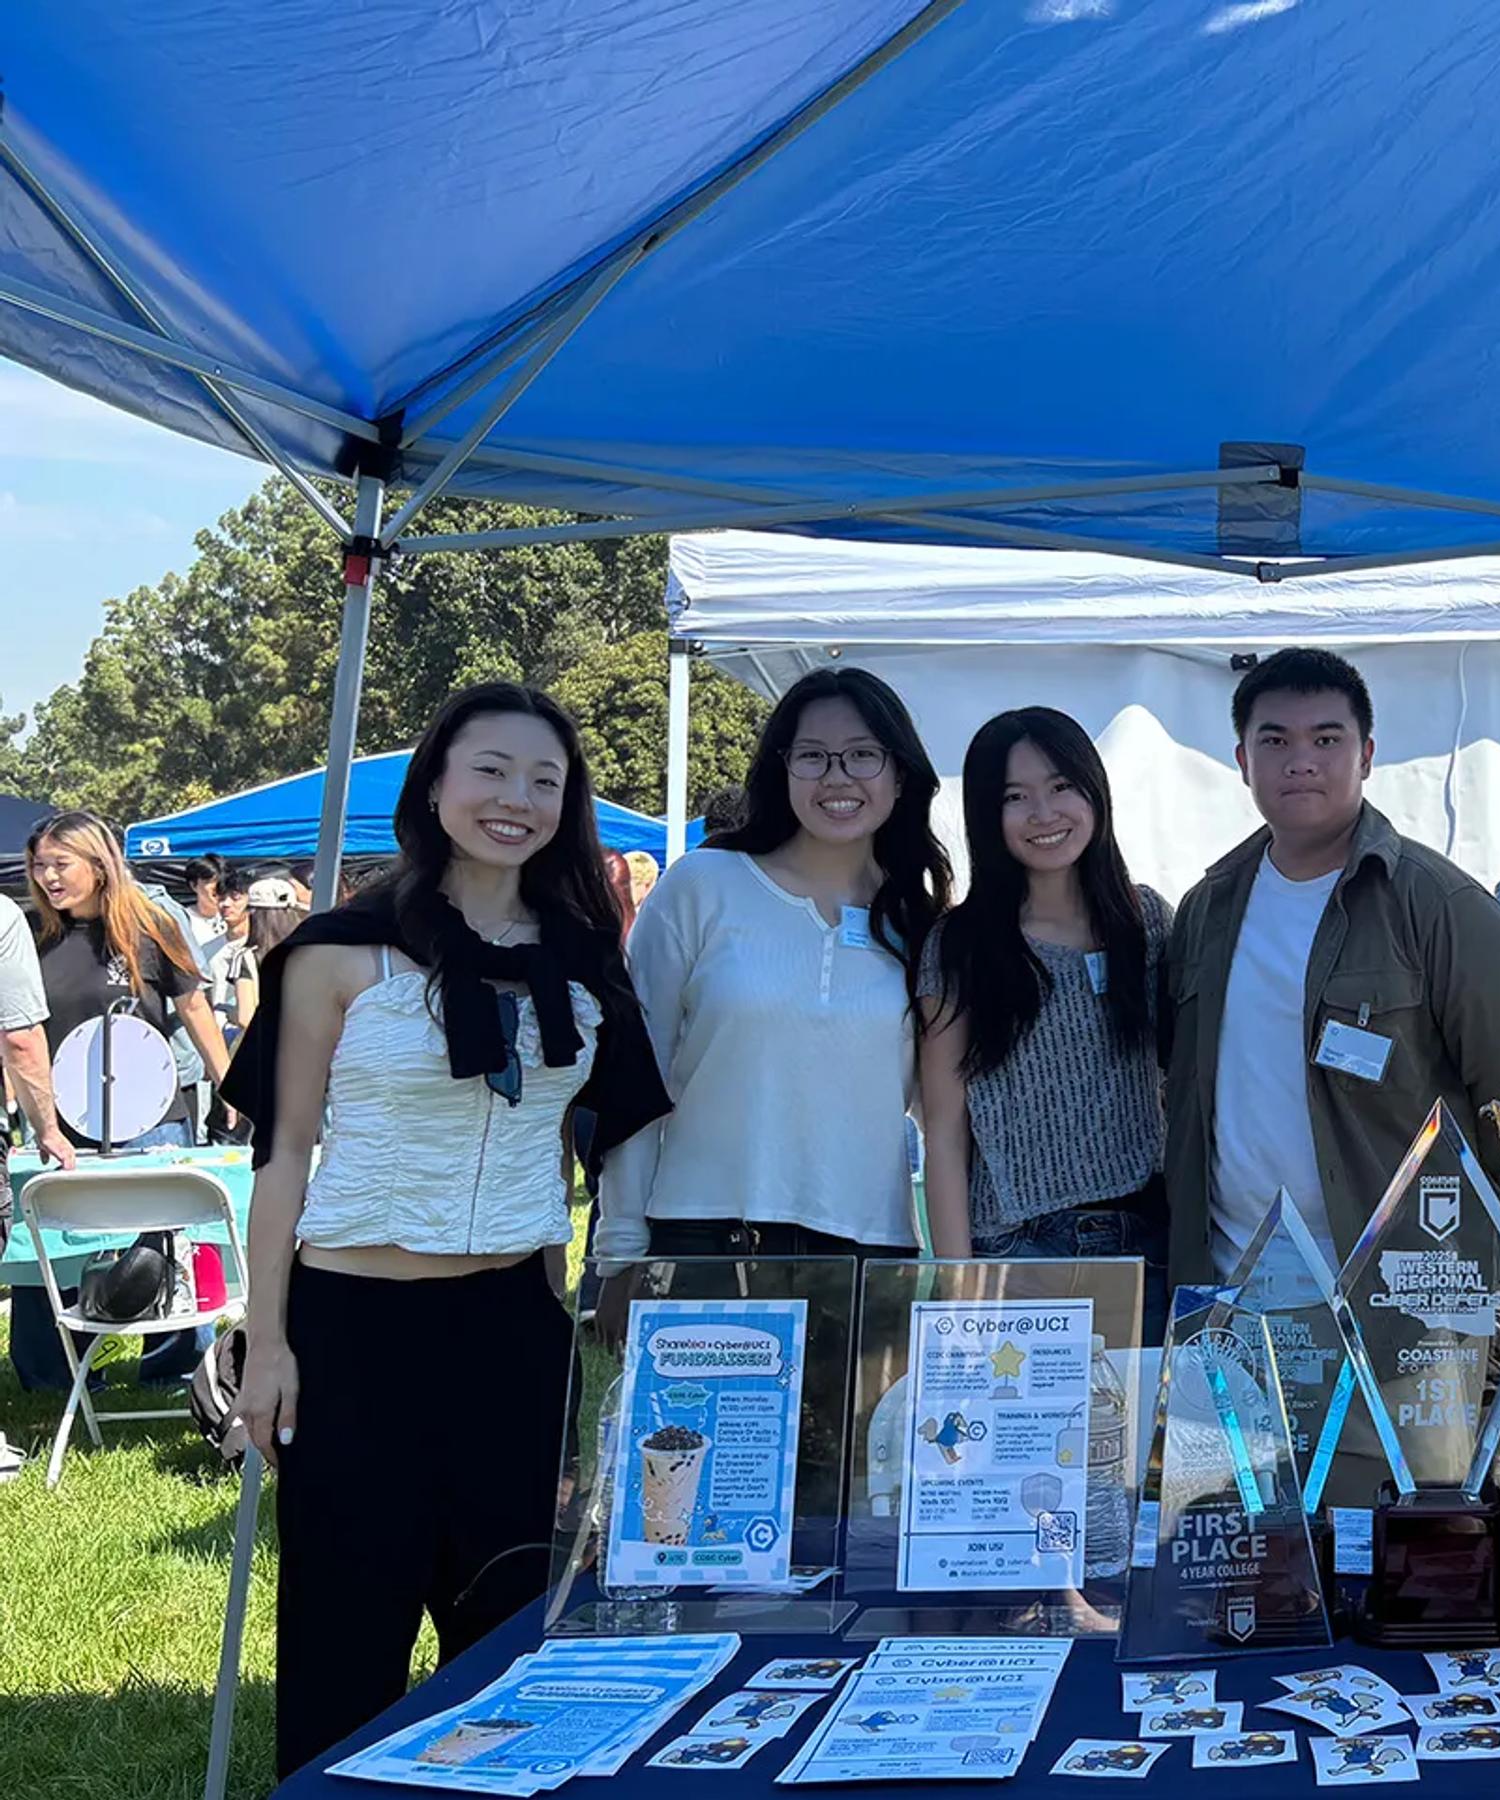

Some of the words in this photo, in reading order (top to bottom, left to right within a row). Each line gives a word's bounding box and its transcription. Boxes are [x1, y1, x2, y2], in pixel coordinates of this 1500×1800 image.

[1400, 1261, 1479, 1274] WESTERN
[1396, 1275, 1488, 1291] REGIONAL
[1369, 1293, 1429, 1306] CYBER
[962, 1316, 1070, 1336] Cyber@UCI
[660, 1351, 772, 1367] FUNDRAISER!
[1397, 1348, 1479, 1361] COASTLINE
[1416, 1378, 1458, 1401] 1ST
[1398, 1404, 1478, 1426] PLACE
[1178, 1511, 1256, 1537] FIRST
[1172, 1535, 1268, 1564] PLACE
[1180, 1567, 1188, 1580] 4
[1189, 1566, 1216, 1579] YEAR
[1216, 1562, 1260, 1577] COLLEGE
[921, 1658, 1038, 1668] Cyber@UCI
[906, 1674, 1025, 1686] Cyber@UCI
